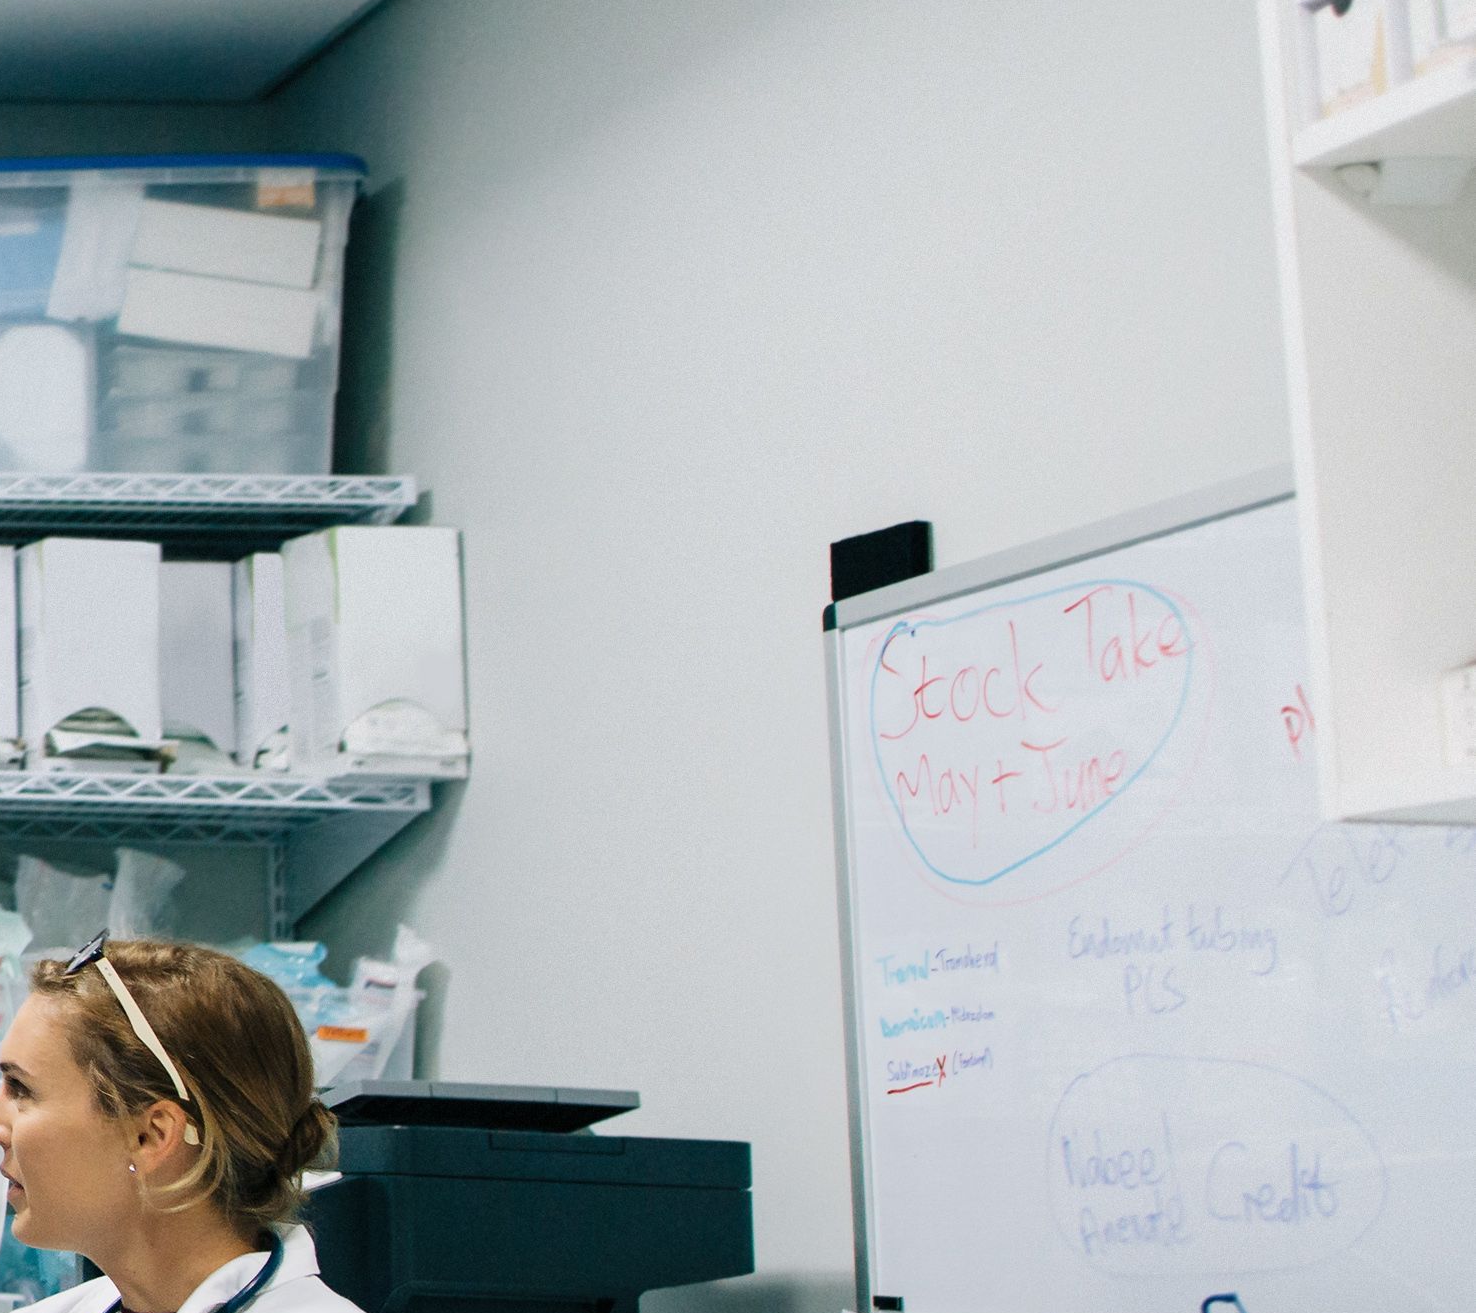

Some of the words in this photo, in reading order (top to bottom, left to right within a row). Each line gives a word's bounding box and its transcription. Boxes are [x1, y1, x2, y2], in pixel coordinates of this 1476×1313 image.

[880, 620, 1058, 740] Stock
[1063, 585, 1189, 682] Take
[896, 753, 979, 849] May
[1020, 736, 1124, 813] June
